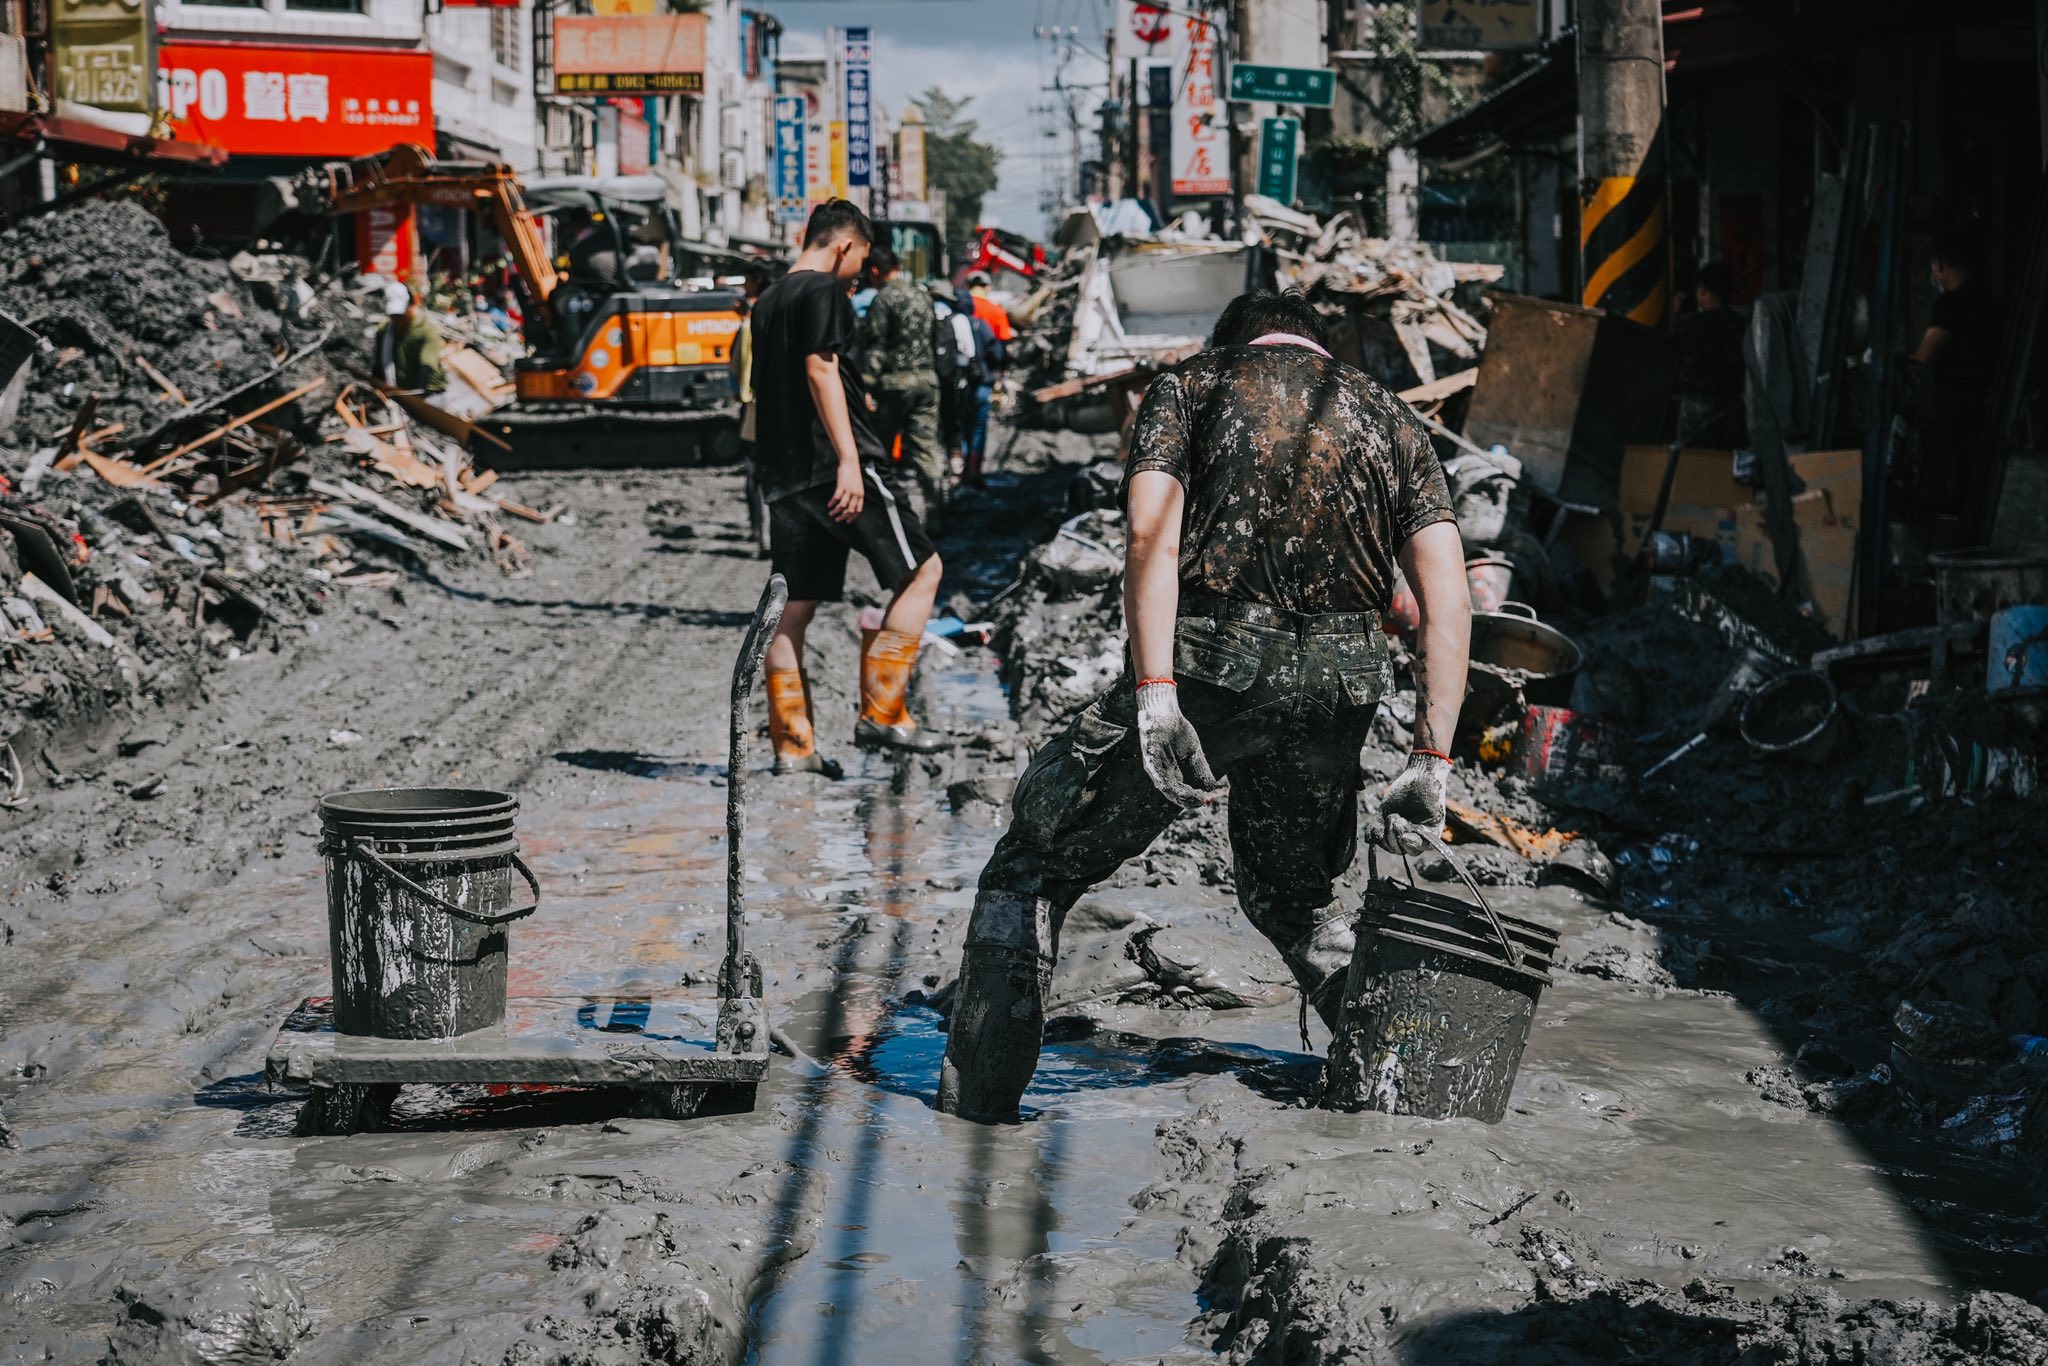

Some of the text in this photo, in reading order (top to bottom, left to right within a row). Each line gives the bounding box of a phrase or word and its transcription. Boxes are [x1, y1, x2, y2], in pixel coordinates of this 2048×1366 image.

[243, 71, 329, 123] 聲寶
[848, 70, 869, 176] 全聯福利中心
[1268, 131, 1286, 200] 中山路二
[687, 319, 742, 335] HITACH
